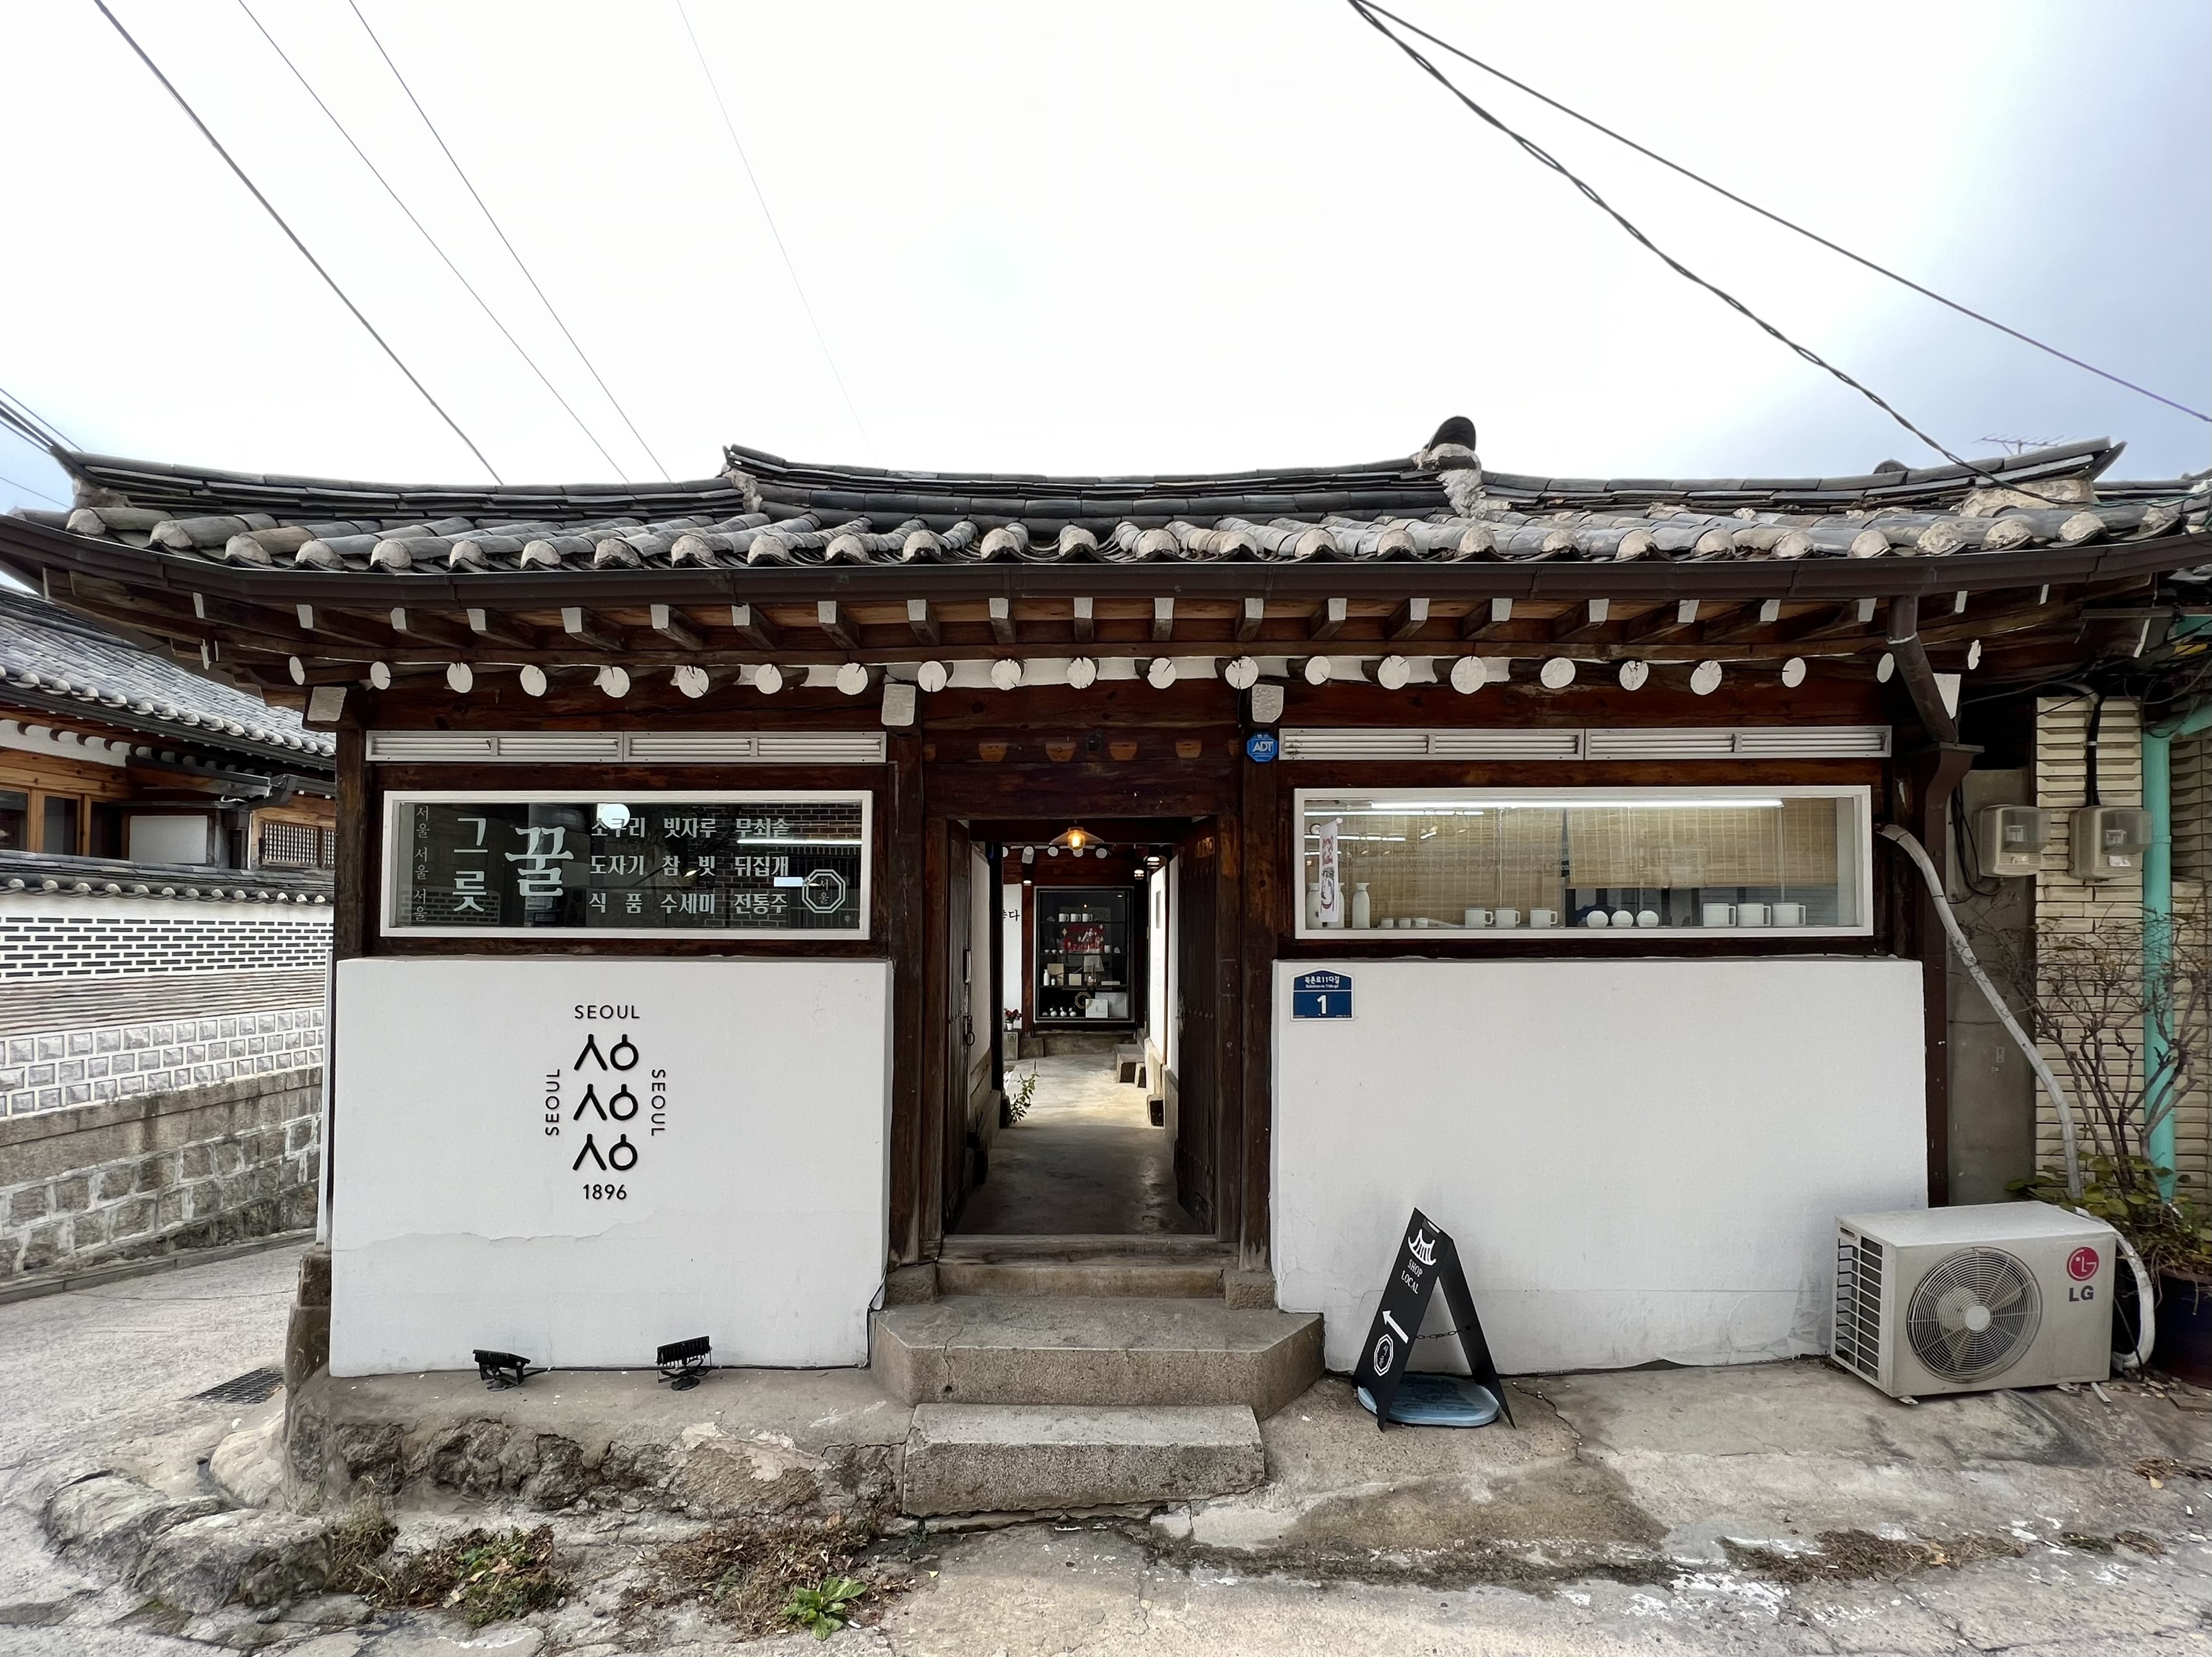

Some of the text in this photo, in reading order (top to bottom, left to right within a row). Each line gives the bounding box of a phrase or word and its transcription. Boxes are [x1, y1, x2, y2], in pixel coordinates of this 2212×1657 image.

[1252, 741, 1274, 752] ADT
[663, 817, 717, 839] 빗자루
[735, 818, 790, 839] 무쇠솥
[413, 805, 430, 922] 서울 서울 서울
[452, 818, 488, 912] 그릇
[504, 826, 574, 897] 꿀
[589, 855, 644, 876] 도자기
[734, 856, 789, 877] 뒤집개
[818, 878, 830, 904] 서울
[660, 893, 715, 914] 수세미
[733, 893, 788, 914] 전통주
[574, 1004, 640, 1019] SEOUL
[1316, 994, 1327, 1014] 1
[545, 1069, 560, 1136] SEOUL
[651, 1069, 666, 1137] SEOUL
[582, 1183, 628, 1200] 1896
[1407, 1259, 1423, 1278] SHOP
[1400, 1270, 1419, 1294] LOCAL
[2069, 1285, 2094, 1302] LG
